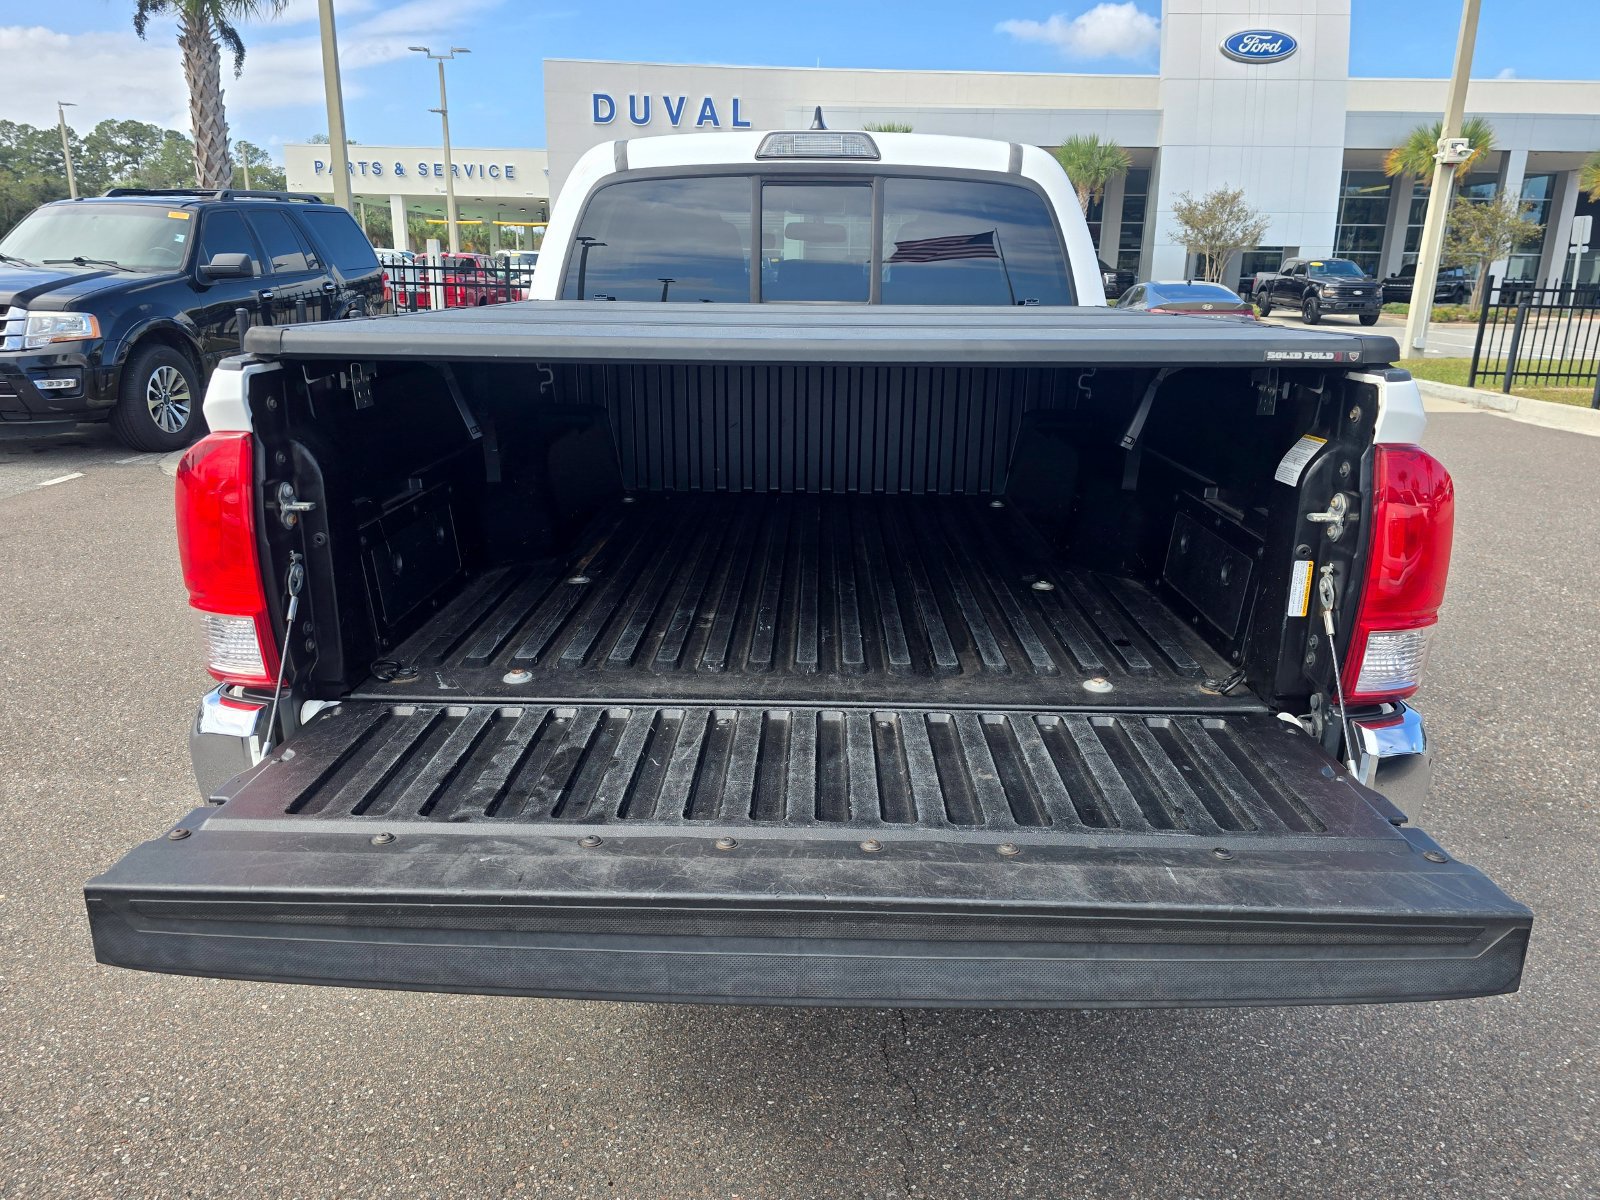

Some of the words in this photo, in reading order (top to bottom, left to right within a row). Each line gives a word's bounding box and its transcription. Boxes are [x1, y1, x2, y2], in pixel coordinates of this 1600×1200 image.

[1238, 34, 1283, 53] Ford
[592, 93, 751, 128] DUVAL
[394, 162, 405, 176] &
[418, 162, 515, 179] SERVICE
[1267, 351, 1302, 360] SOLID
[1304, 351, 1334, 360] FOLD
